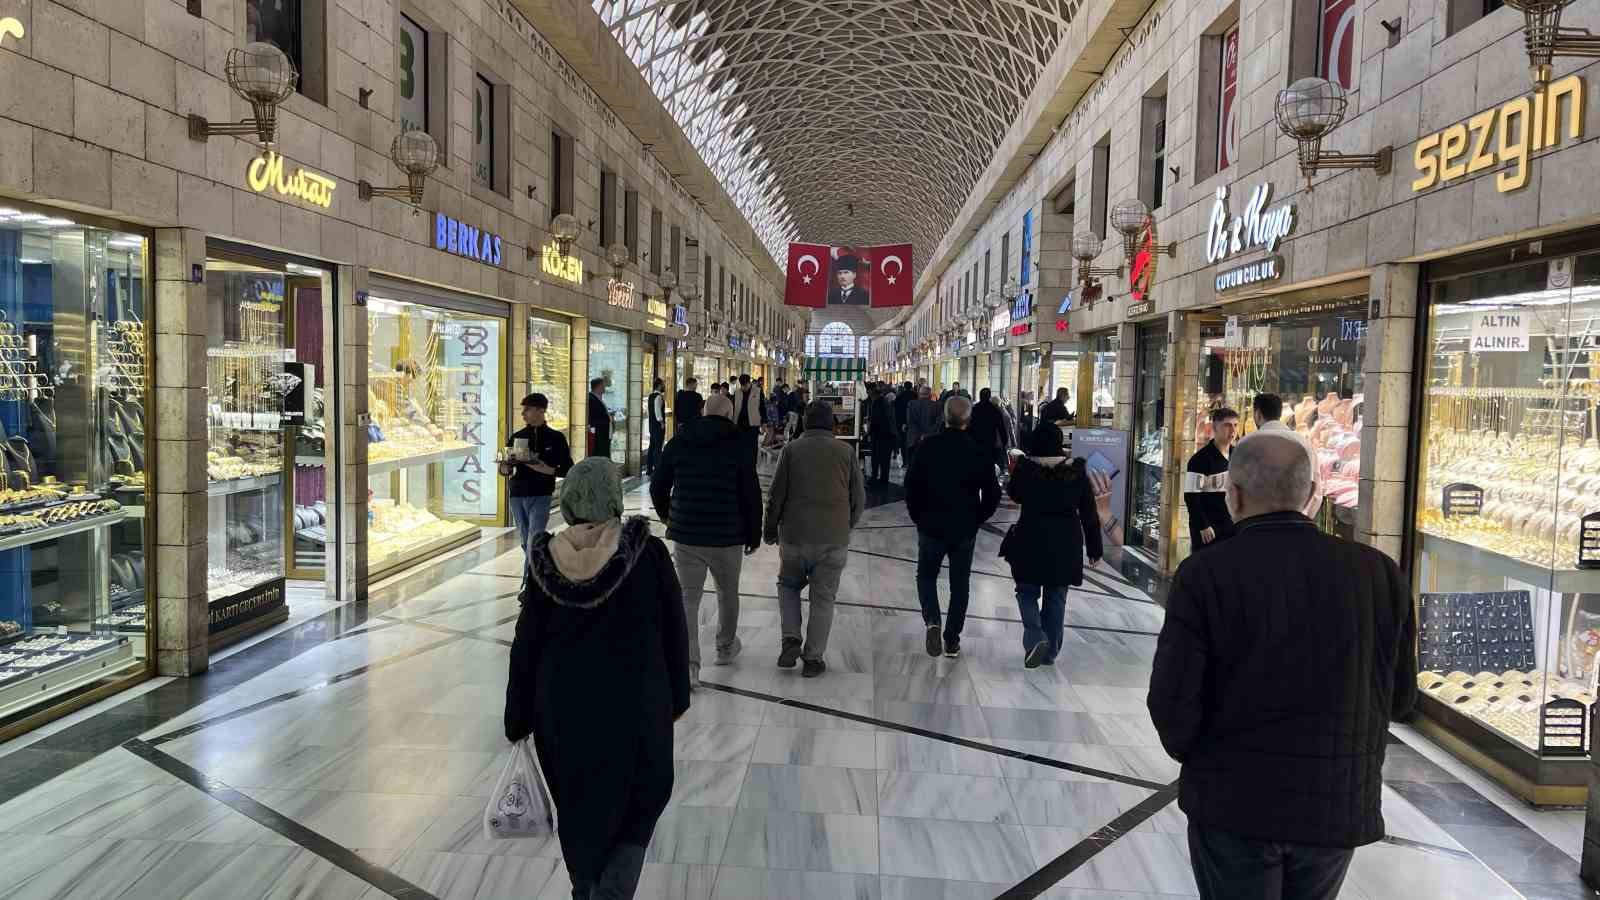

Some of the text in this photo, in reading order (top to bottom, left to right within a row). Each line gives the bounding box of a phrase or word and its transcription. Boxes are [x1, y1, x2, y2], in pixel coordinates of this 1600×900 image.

[1412, 75, 1585, 193] sezgin
[247, 151, 336, 208] Murat
[436, 212, 503, 266] BERKAS
[1207, 186, 1230, 264] Öz
[1243, 182, 1295, 254] Kaya
[1216, 260, 1275, 289] KUYUMCULUK
[1480, 315, 1521, 328] ALTIN
[457, 325, 489, 503] BERKAS
